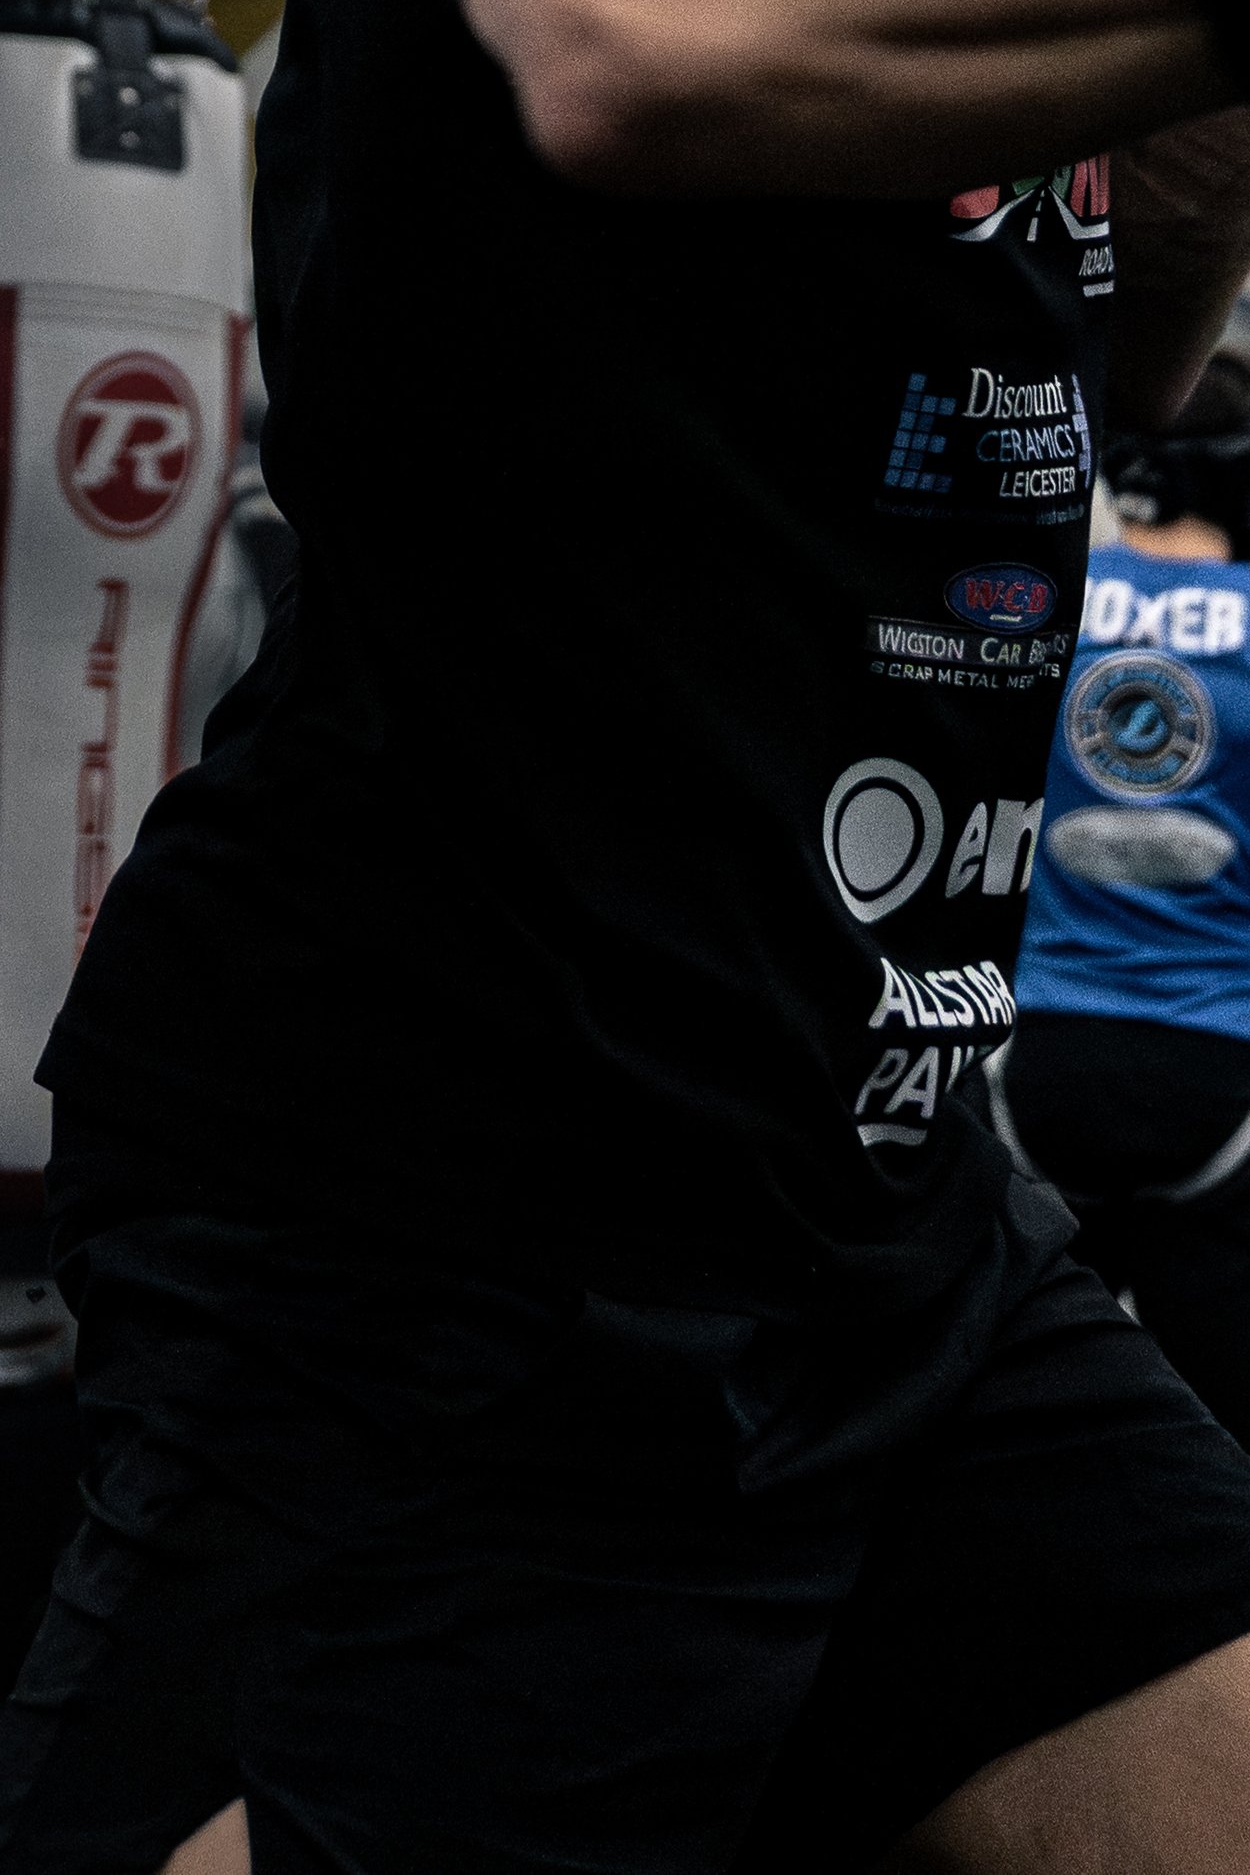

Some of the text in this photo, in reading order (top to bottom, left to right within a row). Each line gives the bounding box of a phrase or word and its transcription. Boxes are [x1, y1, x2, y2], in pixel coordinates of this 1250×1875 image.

[962, 367, 1067, 420] Discount
[976, 424, 1075, 463] CERAMICS
[1000, 466, 1076, 499] LEICESTER
[1083, 577, 1248, 657] OXER
[937, 668, 1001, 690] METAL
[867, 956, 1017, 1029] ALLSTAR
